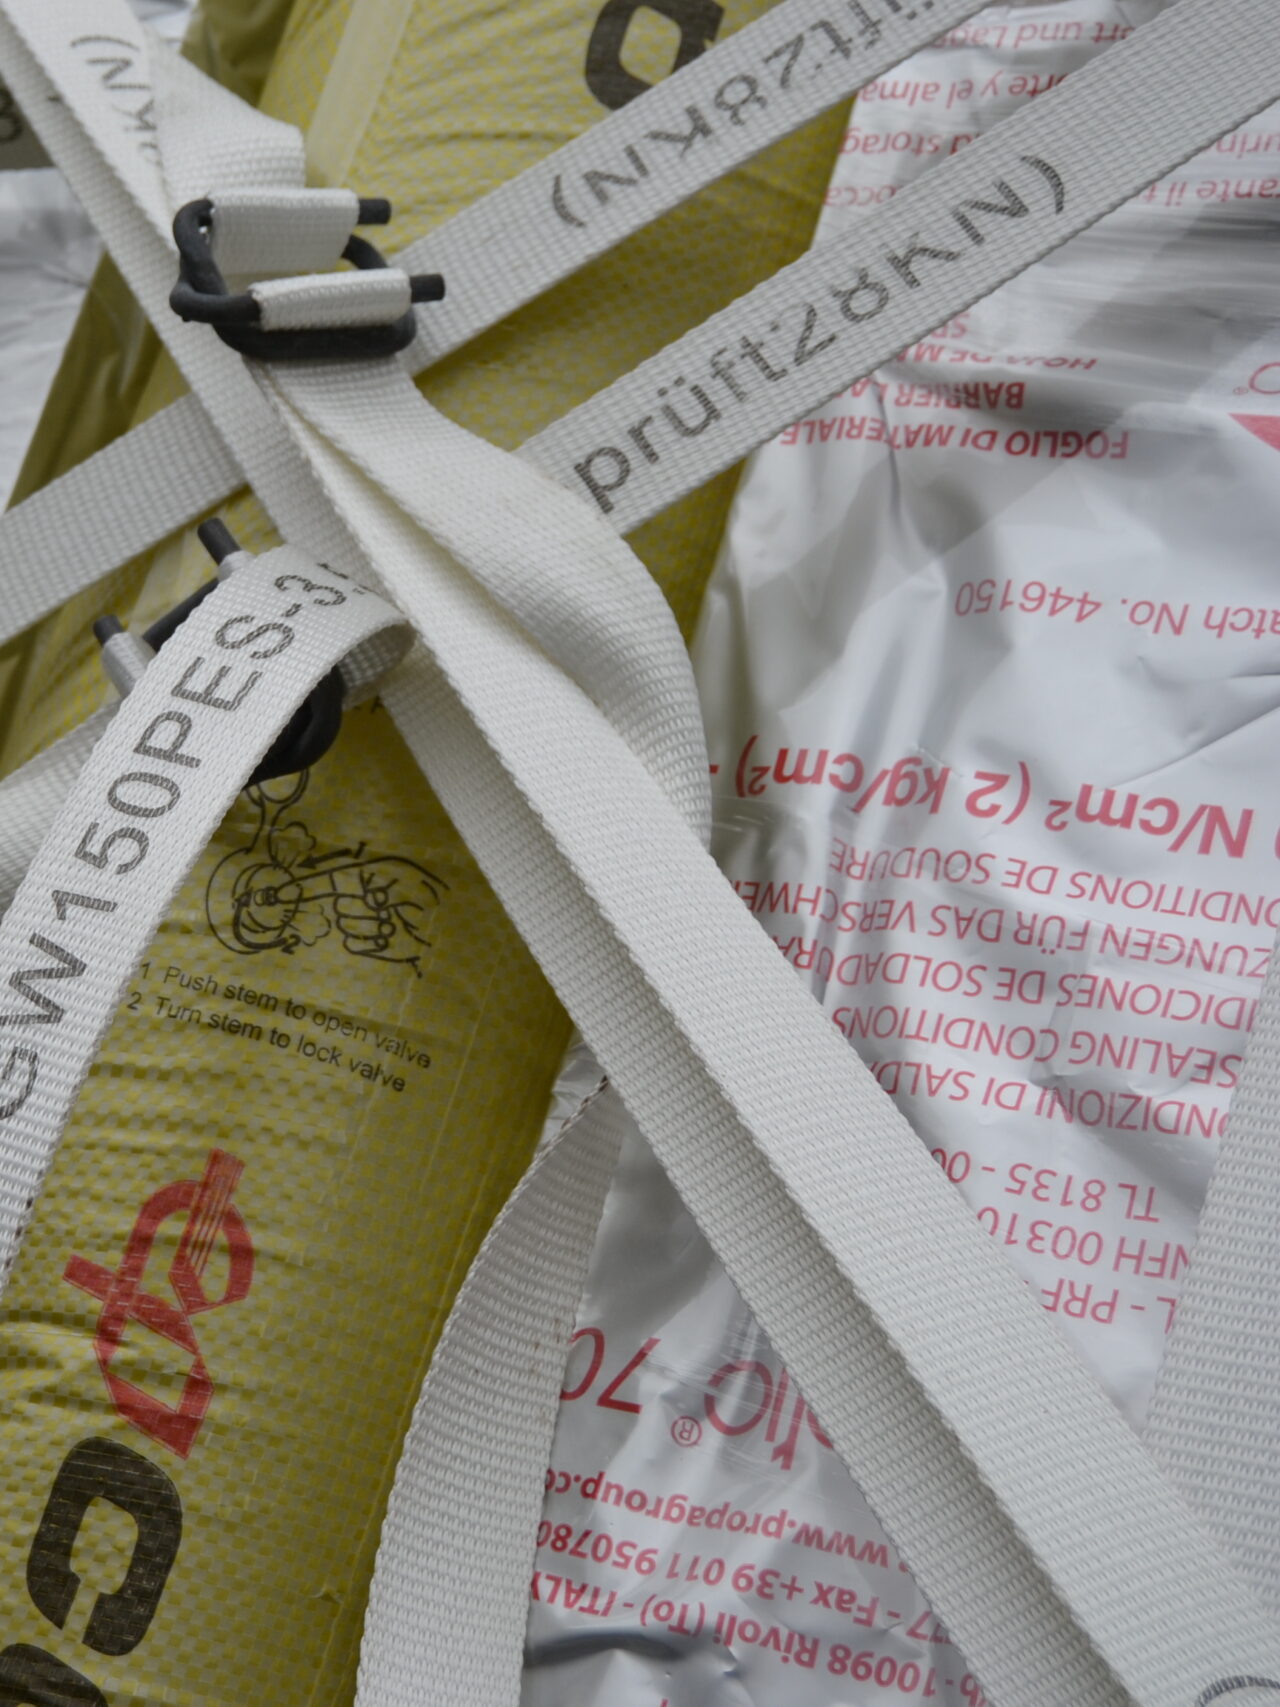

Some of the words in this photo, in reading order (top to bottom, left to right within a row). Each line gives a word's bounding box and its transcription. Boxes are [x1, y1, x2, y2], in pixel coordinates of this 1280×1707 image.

[1013, 21, 1083, 48] und
[945, 78, 974, 109] el
[980, 70, 1003, 99] y
[893, 380, 1026, 410] BARRIER
[780, 415, 956, 450] MATERIALE
[959, 426, 999, 452] DI
[1004, 428, 1130, 460] FOGLIO
[953, 578, 1103, 624] 446150
[1119, 597, 1190, 637] No.
[964, 761, 1031, 826] (2
[827, 837, 996, 885] SOUDURE
[1000, 857, 1060, 896] DE
[927, 904, 1005, 944] DAS
[1012, 909, 1092, 956] FÜR
[992, 967, 1047, 1005] DE
[140, 961, 152, 980] 1
[163, 964, 219, 996] Push
[223, 982, 279, 1012] stem
[285, 997, 308, 1021] to
[312, 1009, 369, 1043] open
[374, 1031, 433, 1070] valve
[830, 1004, 1061, 1063] CONDITIONS
[126, 990, 144, 1011] 2
[154, 996, 202, 1026] Turn
[207, 1011, 265, 1042] stem
[270, 1025, 292, 1050] to
[296, 1034, 343, 1067] lock
[349, 1056, 407, 1093] valve
[1068, 1030, 1243, 1089] SEALING
[981, 1076, 1028, 1112] DI
[1002, 1162, 1107, 1213] 8135
[1117, 1181, 1161, 1224] TL
[1040, 1277, 1120, 1325] PRF
[665, 1552, 726, 1587] 011
[731, 1562, 805, 1601] +39
[639, 1593, 706, 1639] (To)
[809, 1580, 880, 1629] Fax
[711, 1611, 821, 1670] Rivoli
[826, 1643, 937, 1698] 10098
